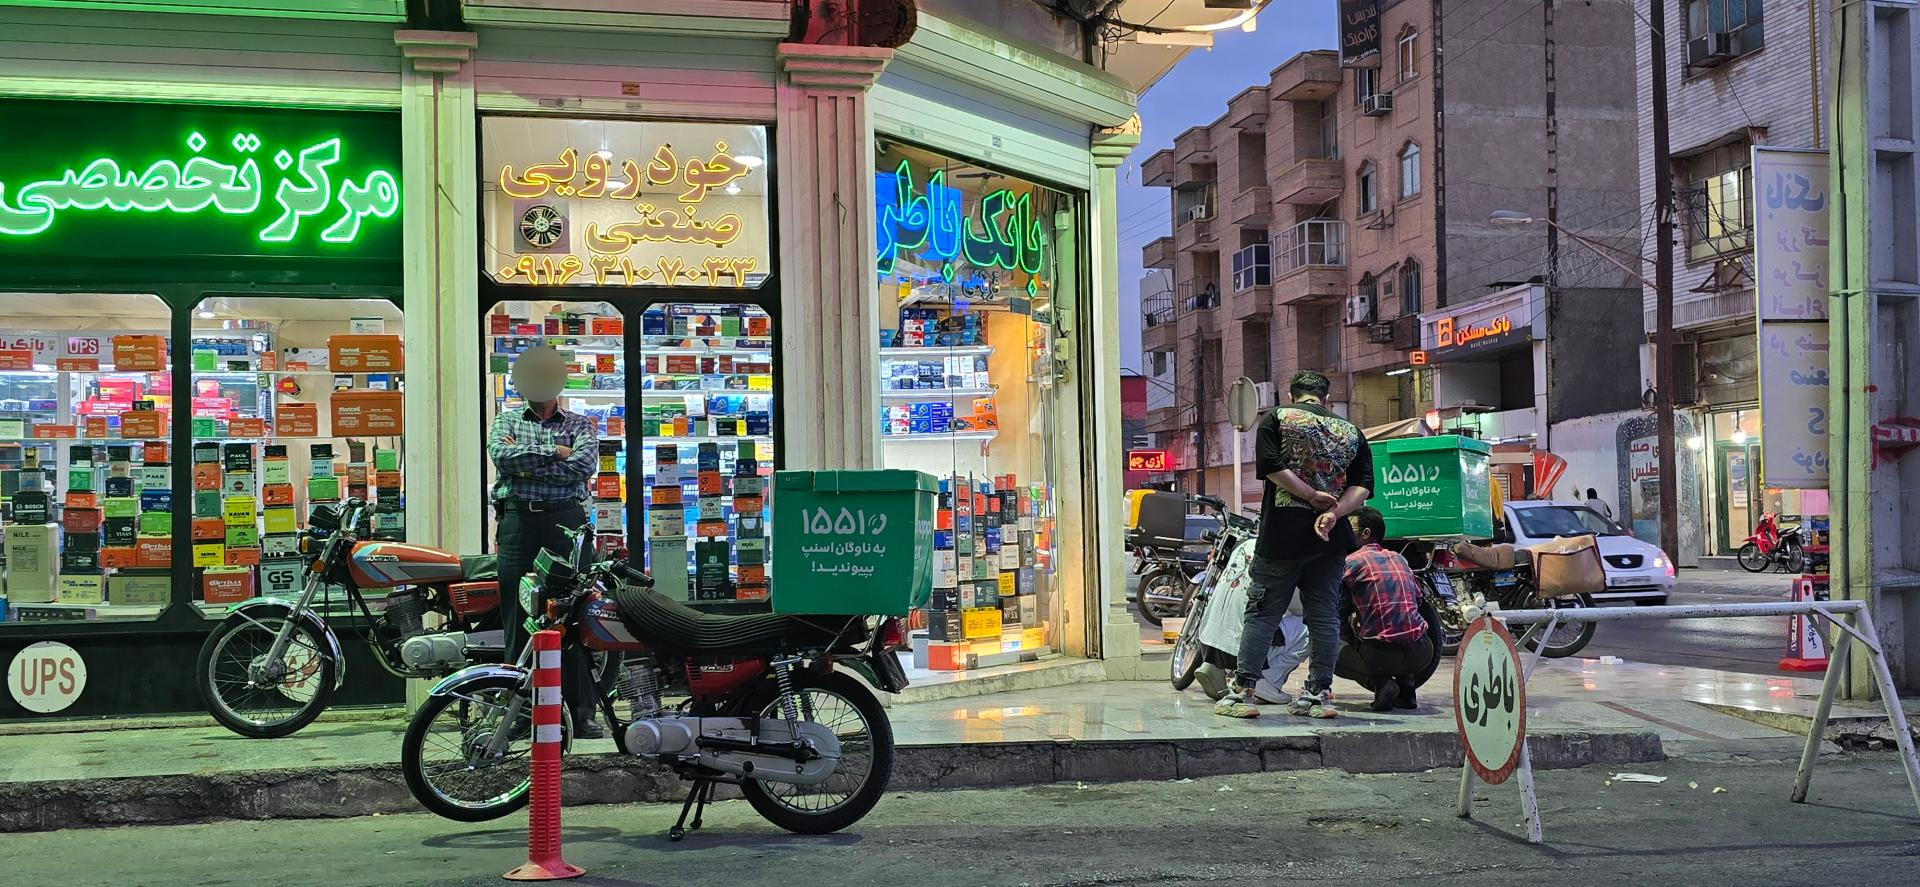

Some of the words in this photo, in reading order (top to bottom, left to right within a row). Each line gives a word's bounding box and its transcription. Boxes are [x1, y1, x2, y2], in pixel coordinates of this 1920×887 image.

[500, 139, 750, 203] خودرویی
[0, 131, 262, 235] تخصصی
[260, 137, 400, 242] مرکز
[585, 202, 743, 255] صنعتی
[876, 158, 961, 283] باطر
[962, 188, 1043, 298] بانک
[499, 254, 584, 286] ۰۹۱۶
[1456, 324, 1487, 346] مسکن
[1485, 315, 1512, 337] بانک
[69, 339, 97, 354] UPS
[1381, 463, 1426, 484] ۱۵۵۱
[1631, 461, 1659, 482] طلس
[1383, 487, 1405, 499] اسنپ
[1406, 486, 1430, 497] ناوگان
[1431, 486, 1441, 497] به
[801, 506, 865, 535] ۱۵۵۱
[801, 541, 834, 558] اسنپ
[835, 542, 872, 556] ناوگان
[872, 544, 886, 556] به
[267, 570, 295, 584] GS
[20, 656, 76, 697] UPS
[1463, 651, 1516, 731] باطری
